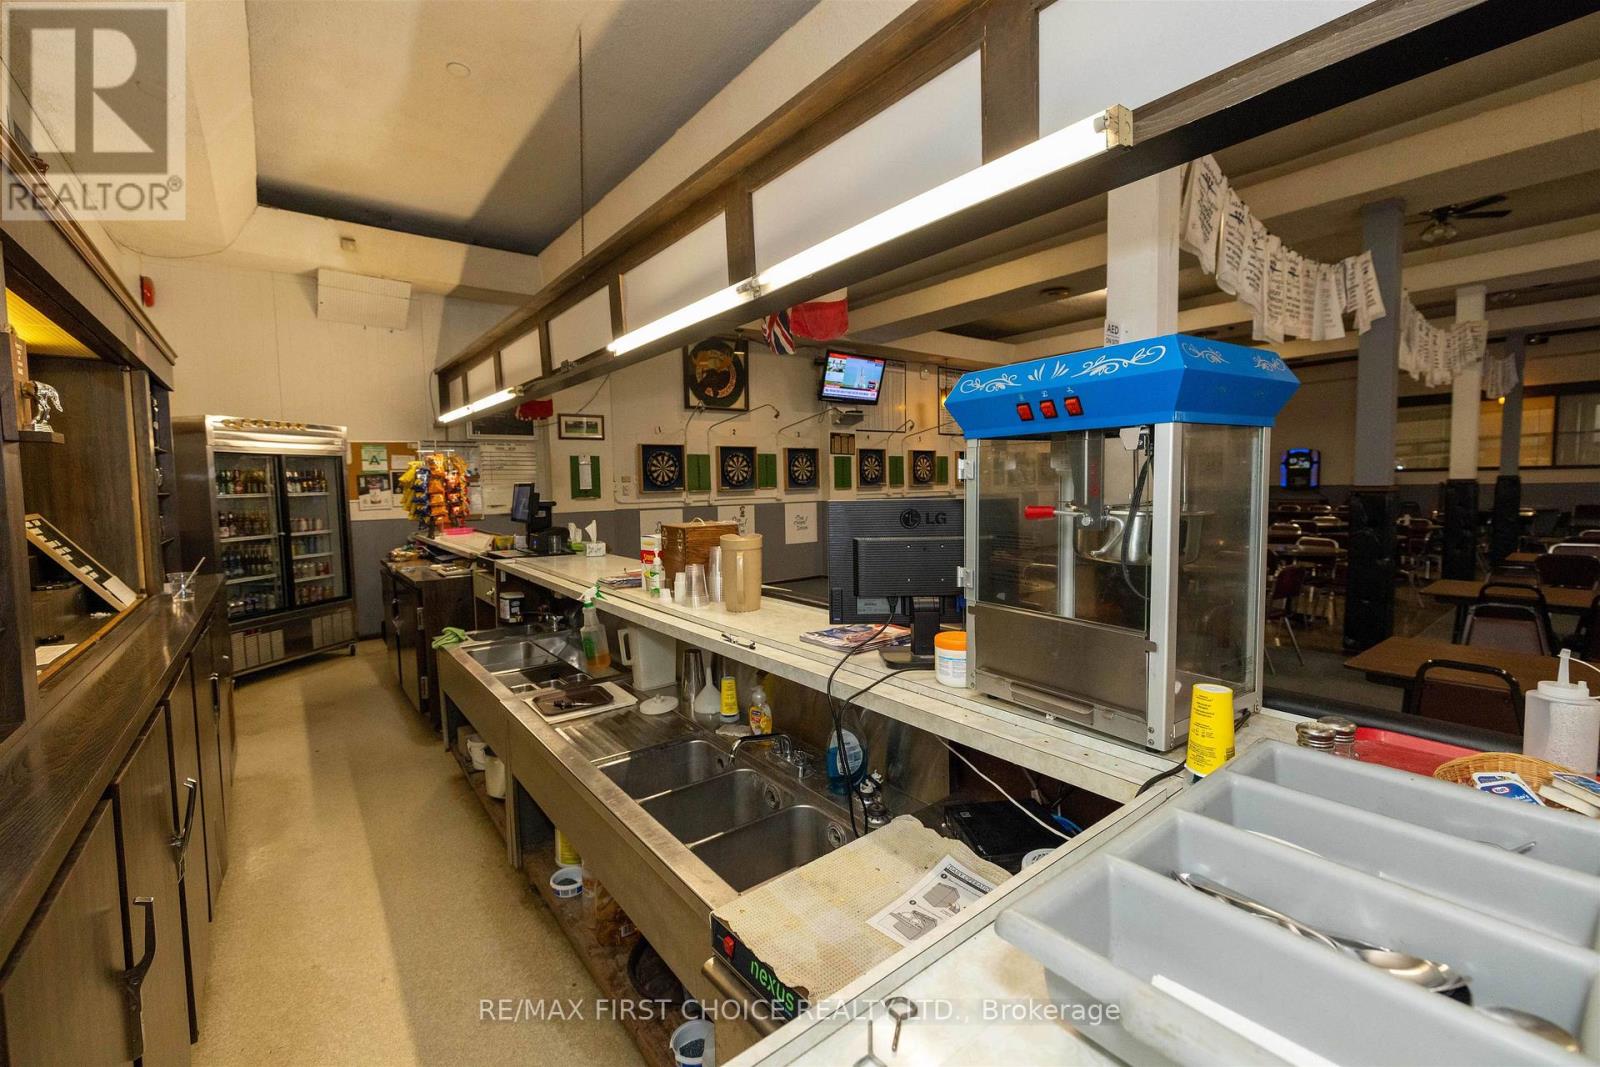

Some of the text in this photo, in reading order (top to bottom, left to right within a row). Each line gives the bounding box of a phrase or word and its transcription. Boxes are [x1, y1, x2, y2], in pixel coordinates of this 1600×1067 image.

[1106, 323, 1119, 335] AED
[925, 512, 947, 525] LG
[750, 961, 794, 1012] nexus
